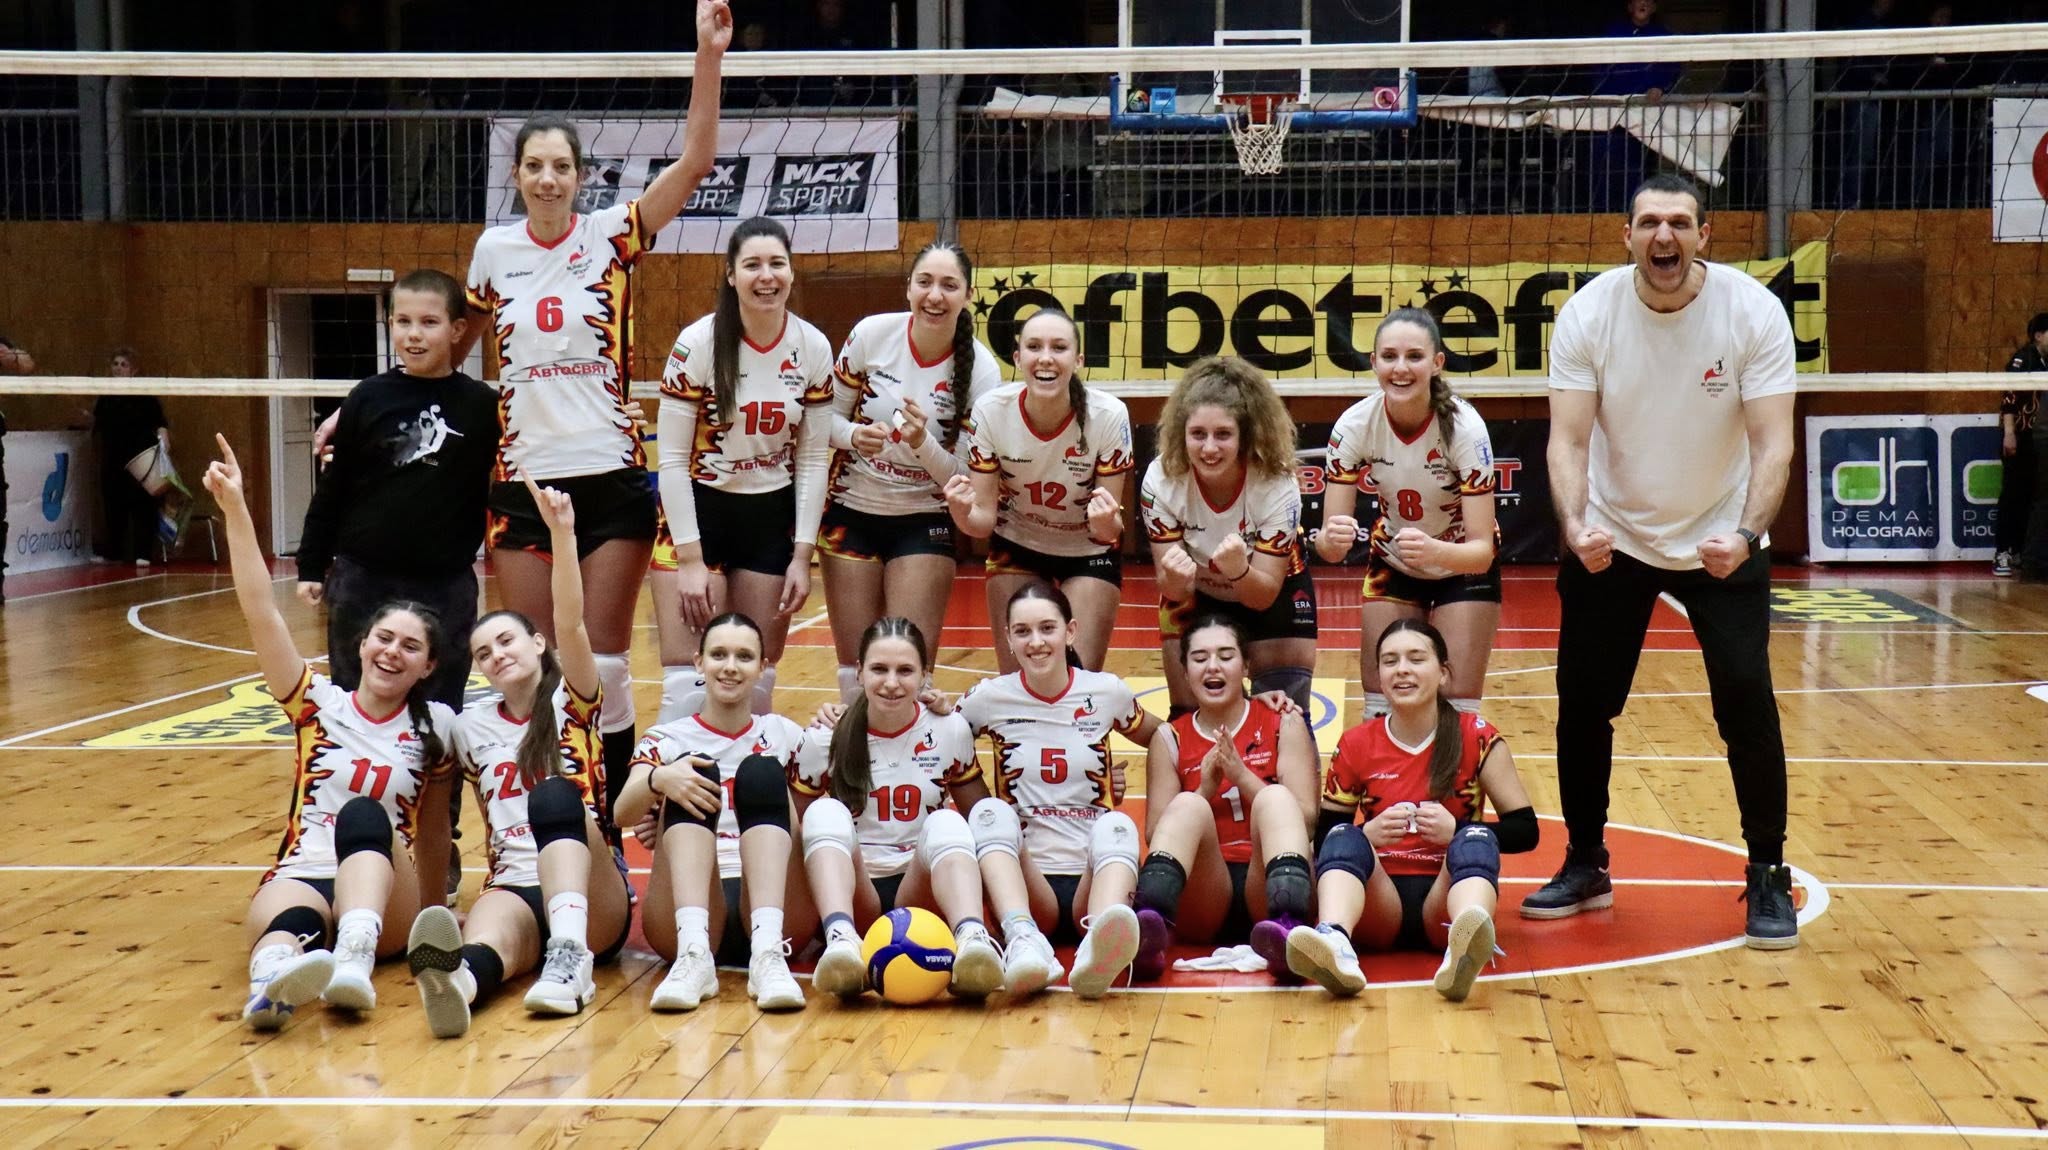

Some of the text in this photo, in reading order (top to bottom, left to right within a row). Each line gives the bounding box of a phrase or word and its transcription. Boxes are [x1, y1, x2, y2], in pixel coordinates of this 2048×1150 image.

[782, 160, 864, 185] MAX
[683, 188, 734, 209] ORT
[779, 185, 854, 209] SPORT
[536, 296, 564, 333] 6
[987, 272, 1383, 372] efbet
[740, 401, 786, 436] 15
[1024, 480, 1068, 512] 12
[1396, 488, 1424, 522] 8
[929, 527, 949, 536] ERA
[1832, 526, 1934, 538] HOLOGRAMS
[1089, 559, 1113, 567] ERA
[1294, 601, 1311, 609] ERA
[348, 757, 392, 801] 11
[1040, 748, 1068, 784] 5
[869, 784, 921, 822] 19
[1221, 785, 1244, 822] 1
